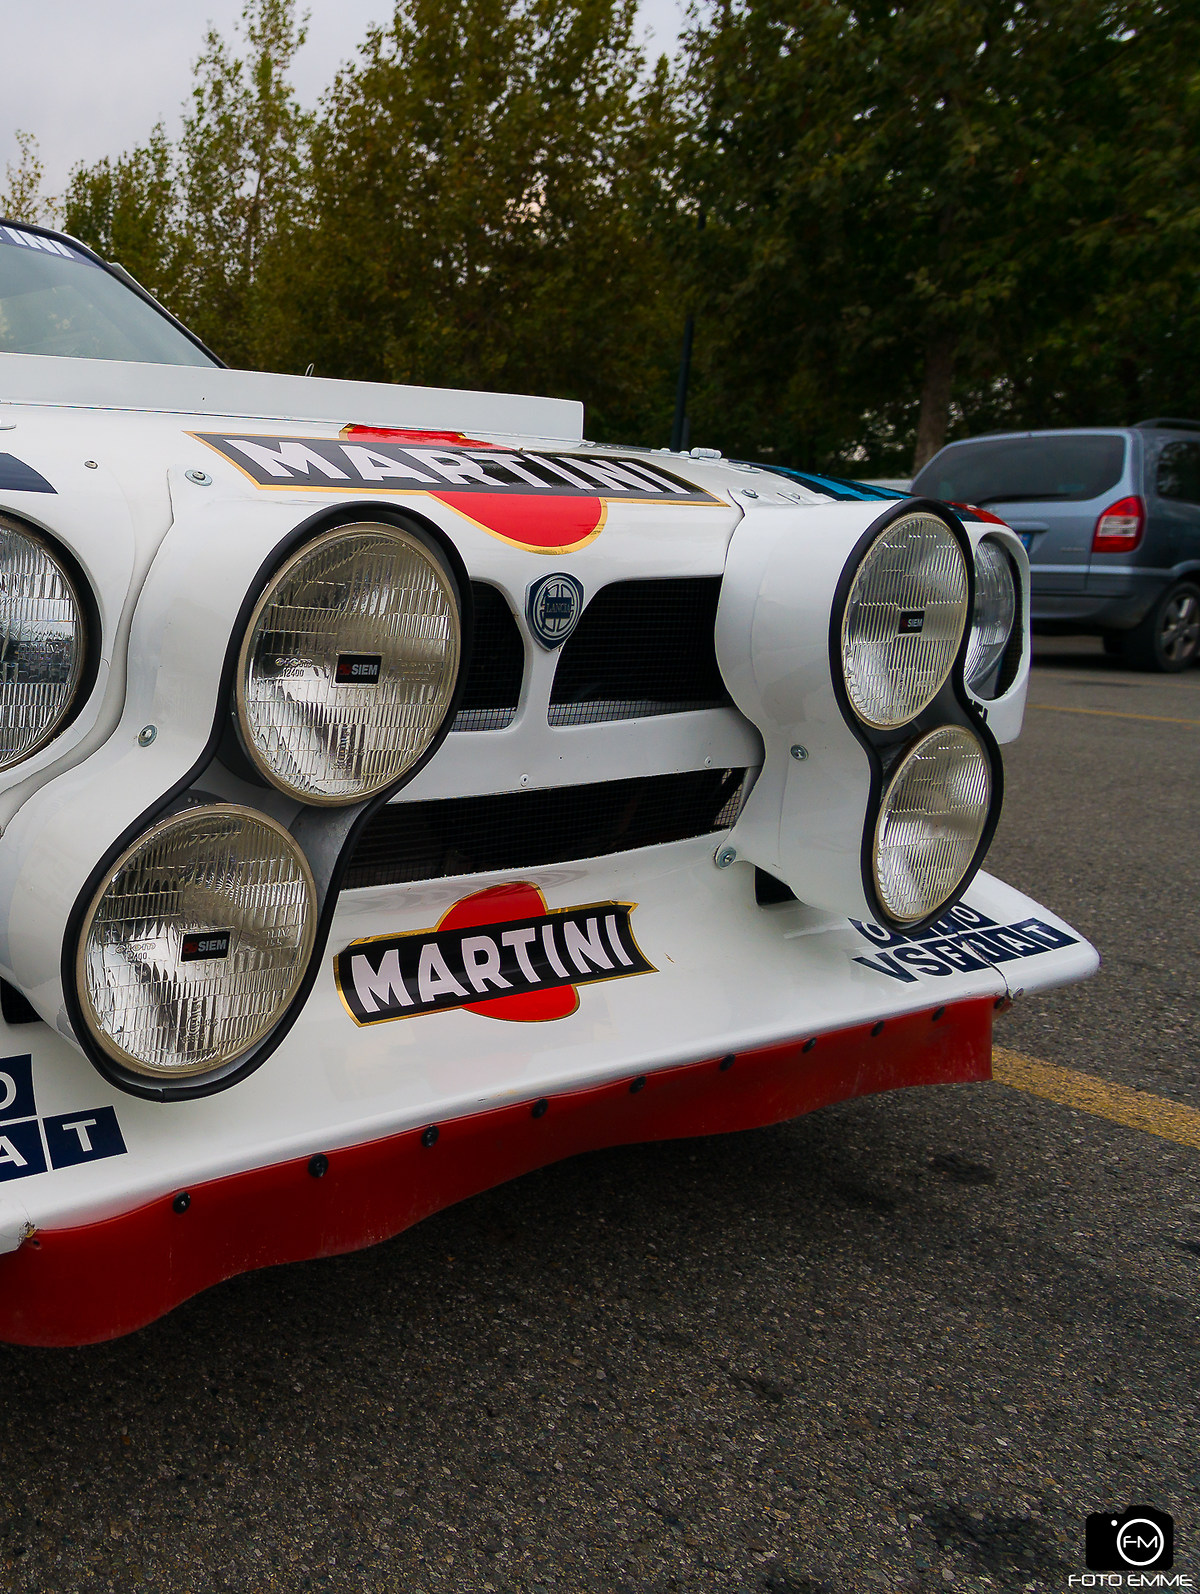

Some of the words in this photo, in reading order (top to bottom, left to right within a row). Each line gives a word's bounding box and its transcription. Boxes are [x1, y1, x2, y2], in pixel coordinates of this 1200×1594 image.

[223, 439, 692, 496] MARTINI
[907, 618, 923, 628] SIEM
[351, 664, 378, 676] SIEM
[198, 939, 227, 952] SIEM
[351, 914, 634, 1014] MARTINI
